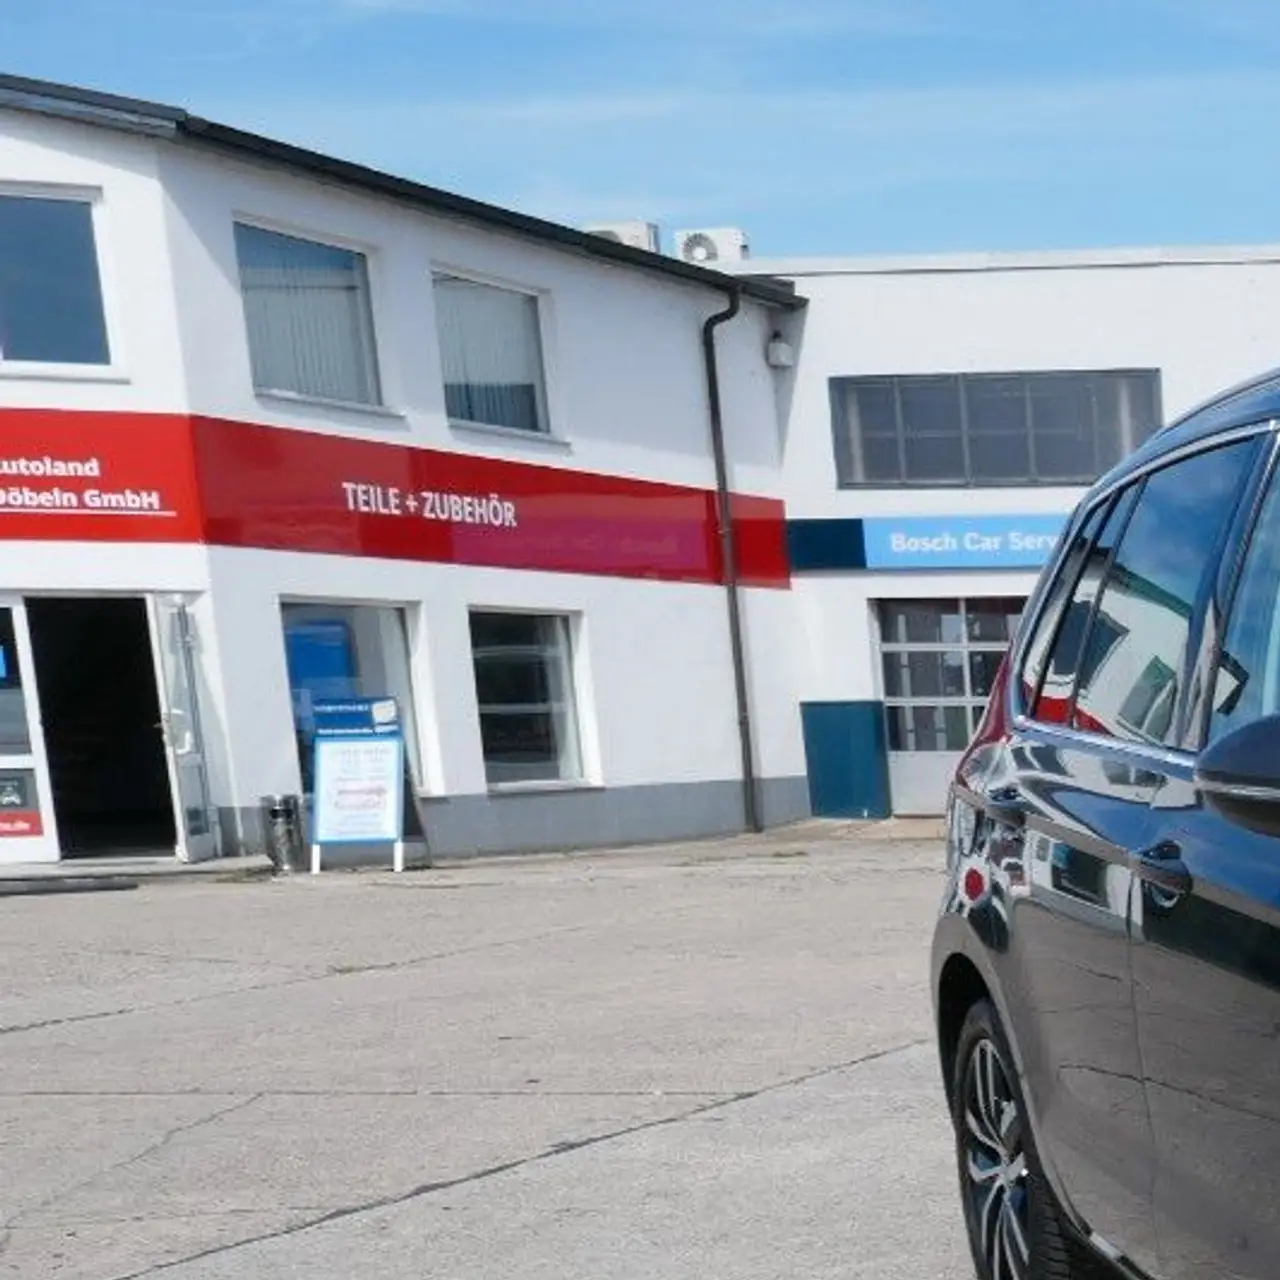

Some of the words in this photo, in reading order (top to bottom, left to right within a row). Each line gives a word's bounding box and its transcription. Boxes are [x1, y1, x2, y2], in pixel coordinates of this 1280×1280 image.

[0, 455, 100, 476] utoland
[83, 489, 160, 509] GmbH
[342, 481, 401, 515] TEILE
[421, 491, 517, 527] ZUBEHÖR
[890, 532, 957, 552] Bosch
[964, 532, 1000, 551] Car
[1008, 532, 1059, 549] Serv
